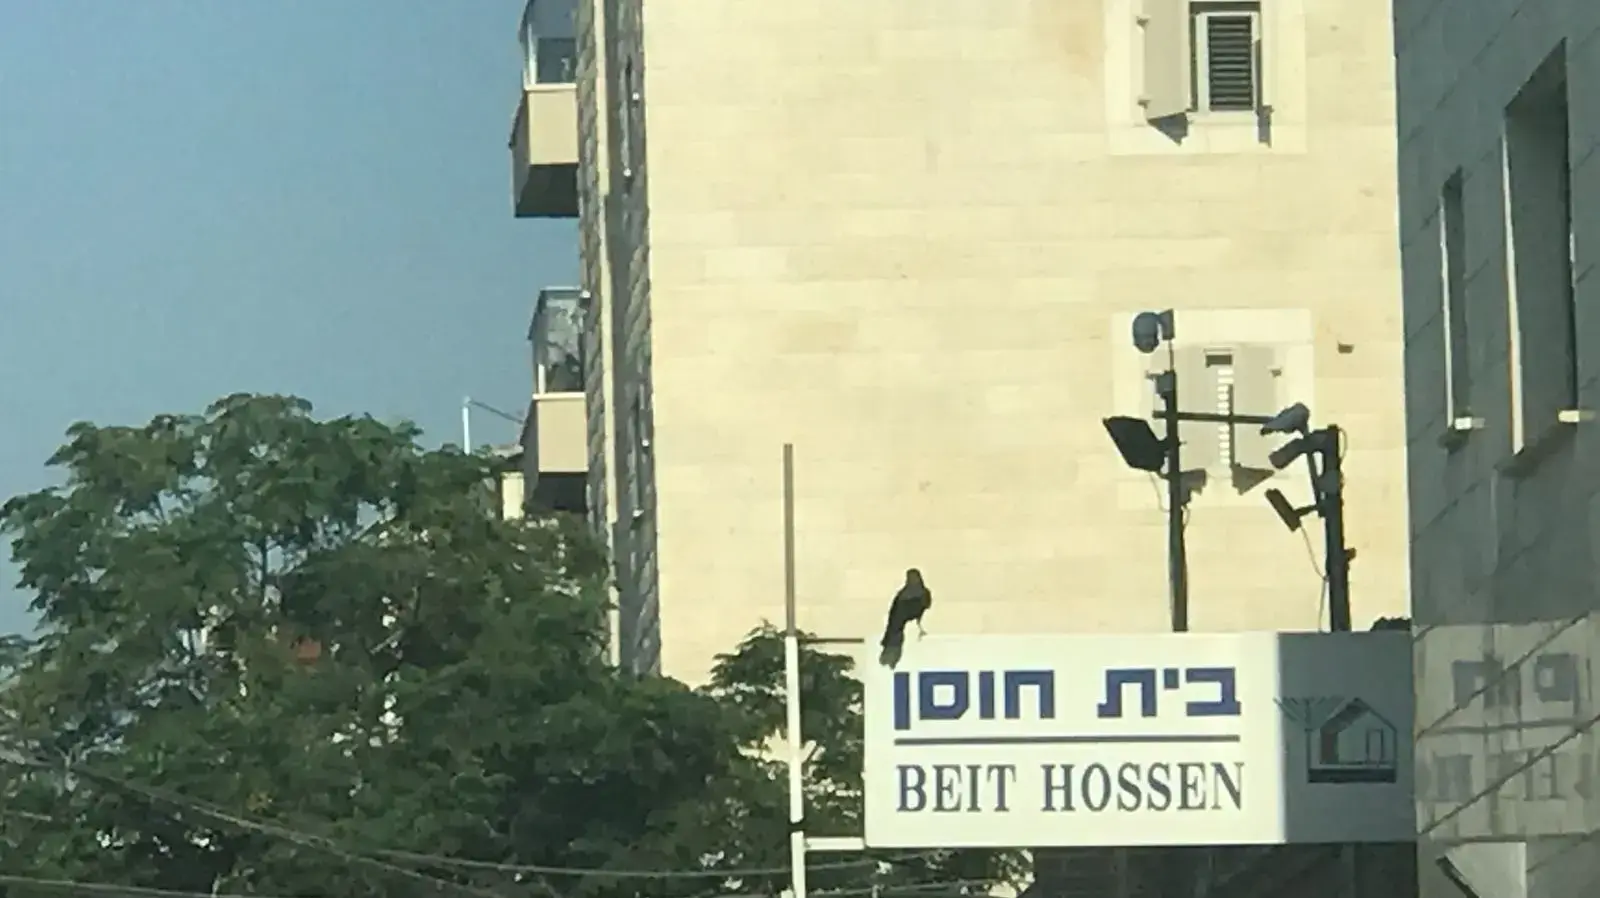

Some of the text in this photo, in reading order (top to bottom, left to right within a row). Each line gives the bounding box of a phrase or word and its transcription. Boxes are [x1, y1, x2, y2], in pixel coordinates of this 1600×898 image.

[893, 667, 1241, 730] בית חוסן
[896, 761, 1245, 813] BEIT HOSSEN
